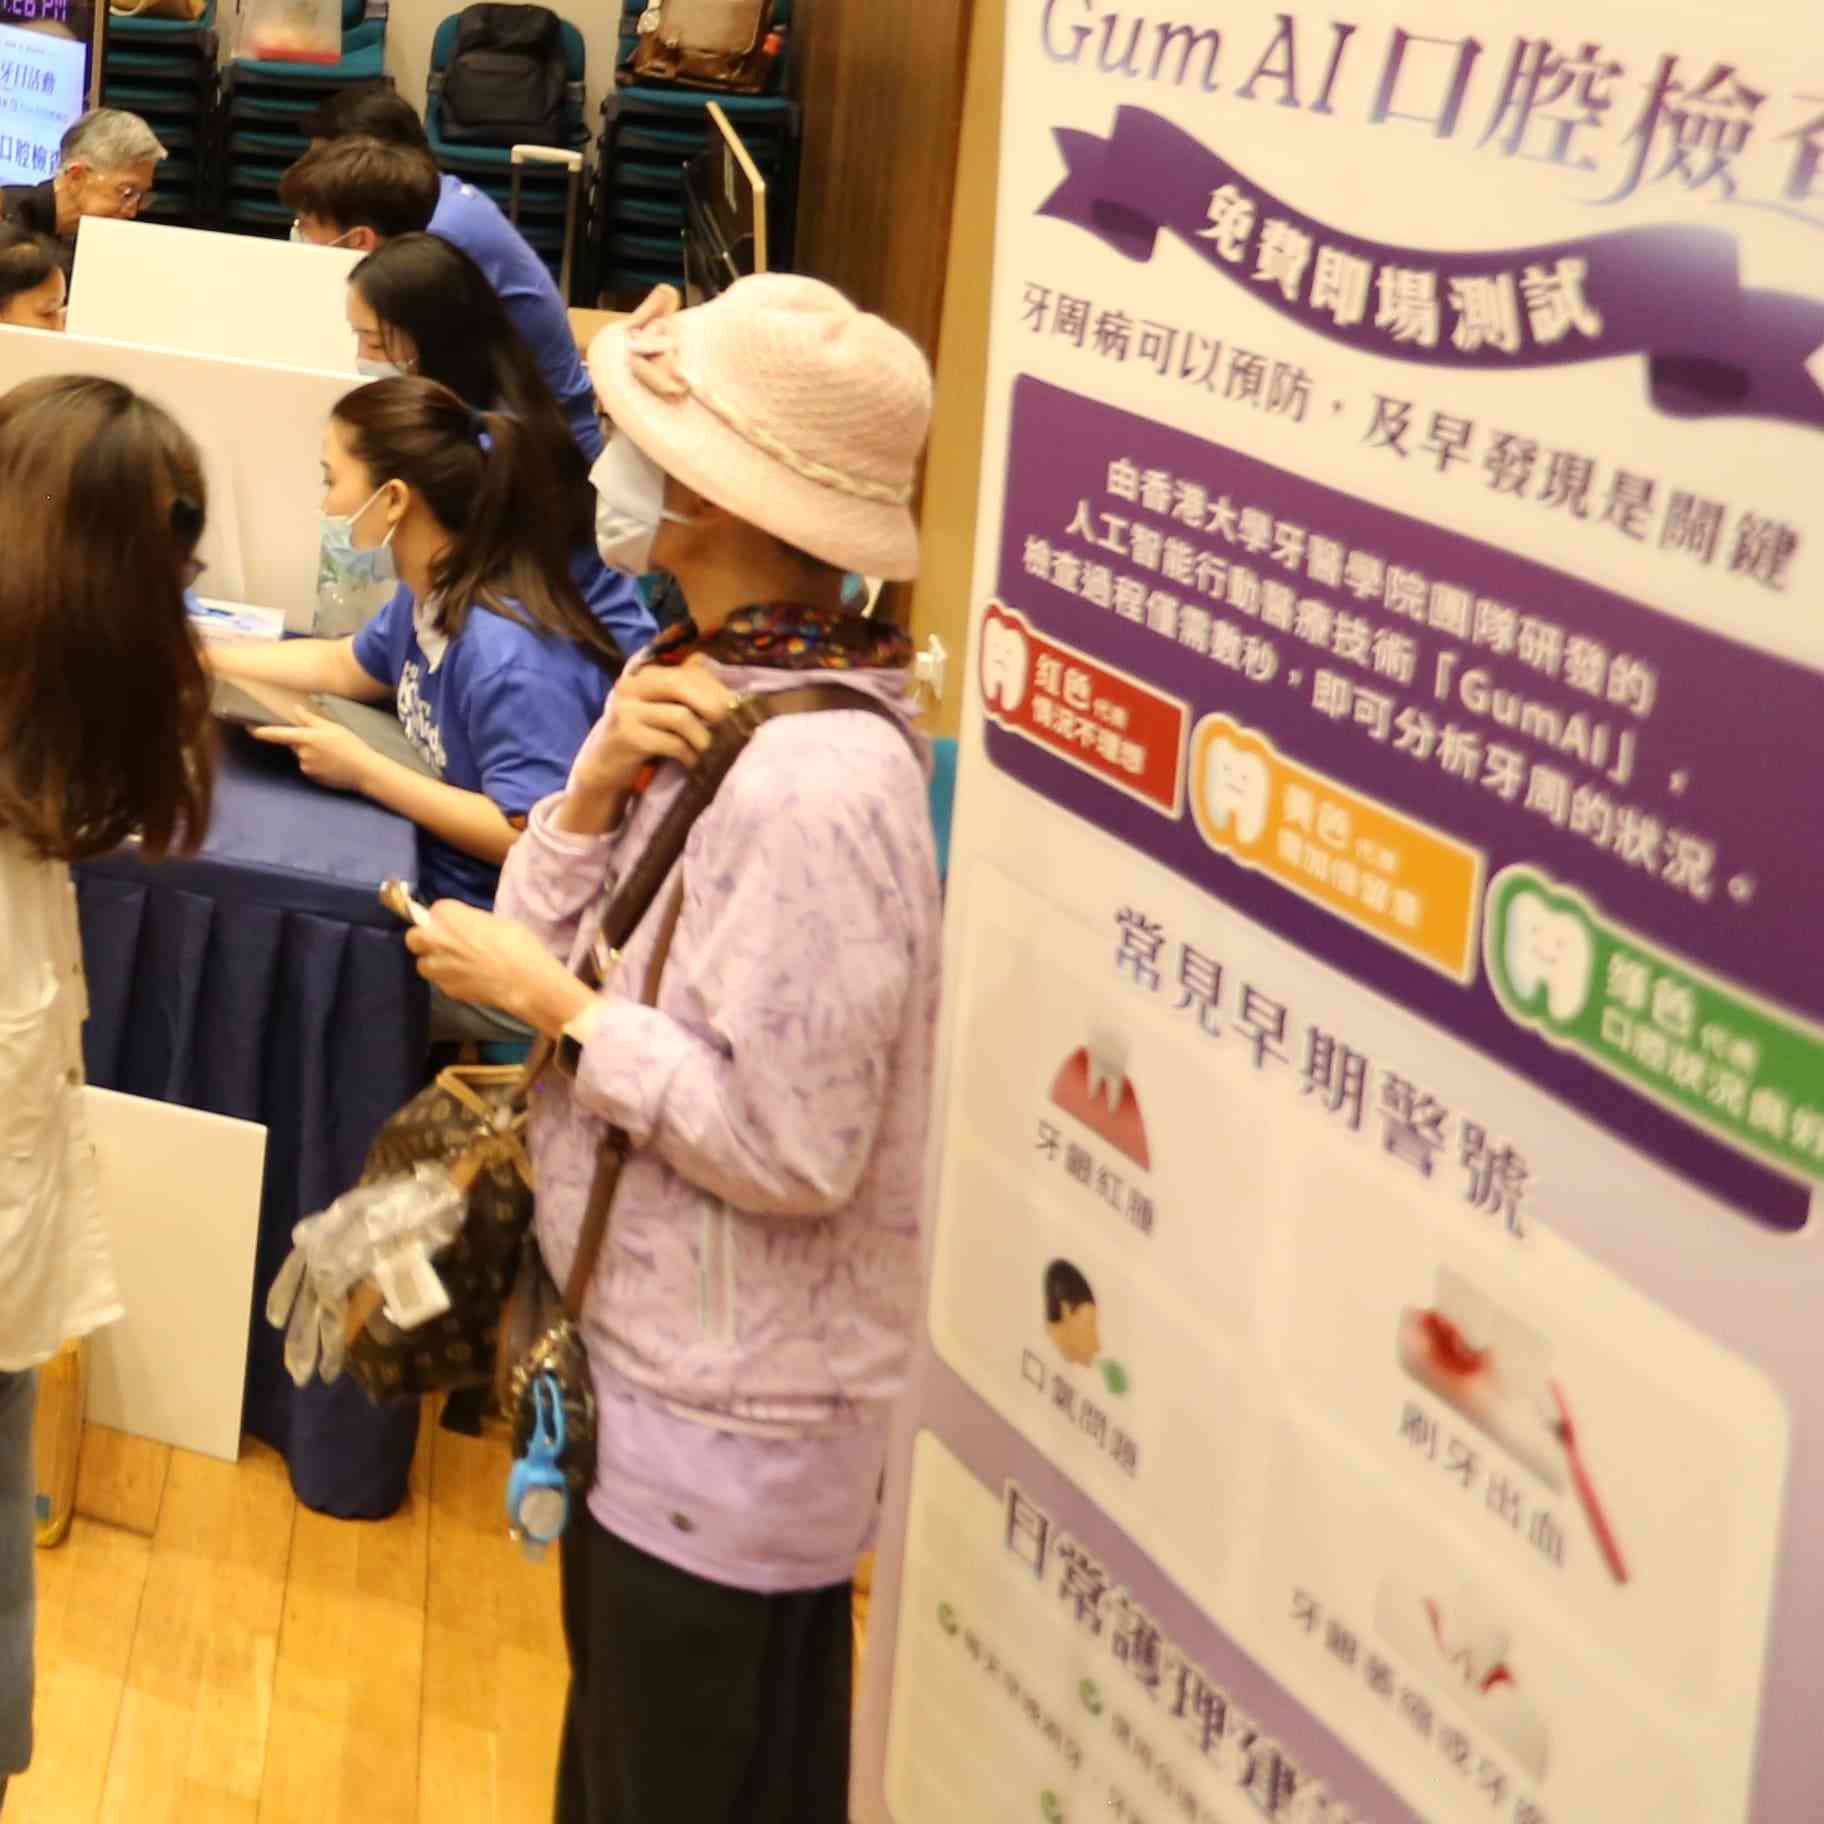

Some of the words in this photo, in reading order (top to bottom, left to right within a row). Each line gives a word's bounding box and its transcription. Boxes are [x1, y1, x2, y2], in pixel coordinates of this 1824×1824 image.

[1234, 12, 1359, 116] AI
[1195, 182, 1604, 355] 免費即場測試
